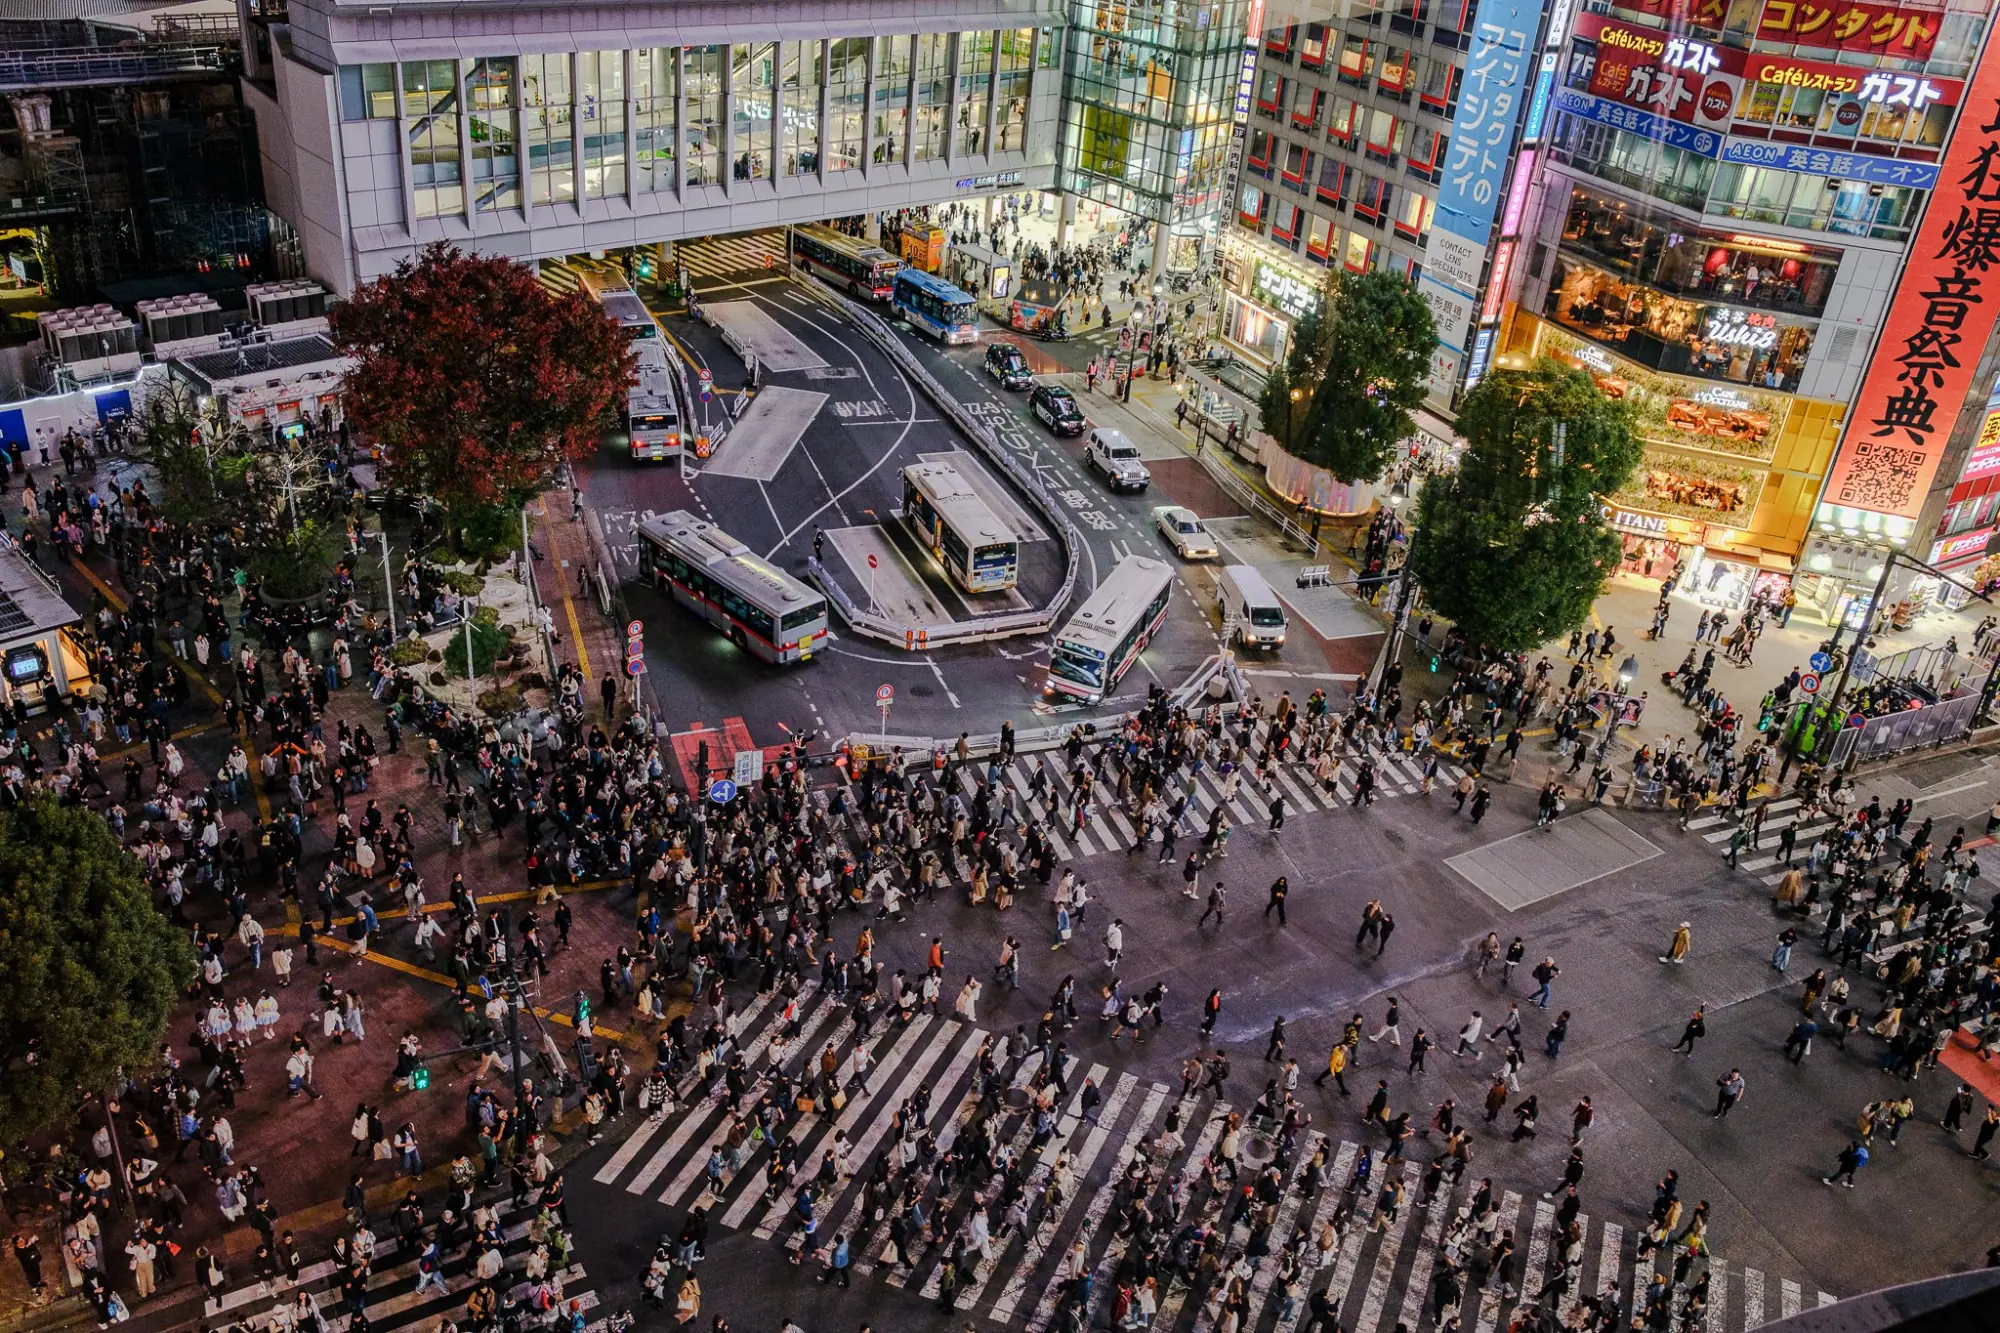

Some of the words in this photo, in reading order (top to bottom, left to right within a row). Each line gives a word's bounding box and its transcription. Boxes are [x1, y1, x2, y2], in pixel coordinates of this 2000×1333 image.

[1761, 1, 1934, 48] コンタクト
[1571, 53, 1596, 76] 7F
[1661, 38, 1721, 75] ガスト
[1625, 66, 1693, 111] ガスト
[1858, 72, 1942, 108] ガスト
[1453, 23, 1506, 198] アイシティ
[1473, 30, 1527, 206] コンタクトの
[1563, 92, 1590, 113] AEON
[1597, 103, 1690, 143] 英会話イーオン
[1729, 142, 1779, 163] AEON
[1787, 146, 1933, 184] 英会話イーオン
[1440, 238, 1472, 259] CONTACT
[1444, 252, 1461, 267] LENS
[1430, 257, 1473, 283] SPECIALISTS
[1600, 507, 1669, 532] CITANE
